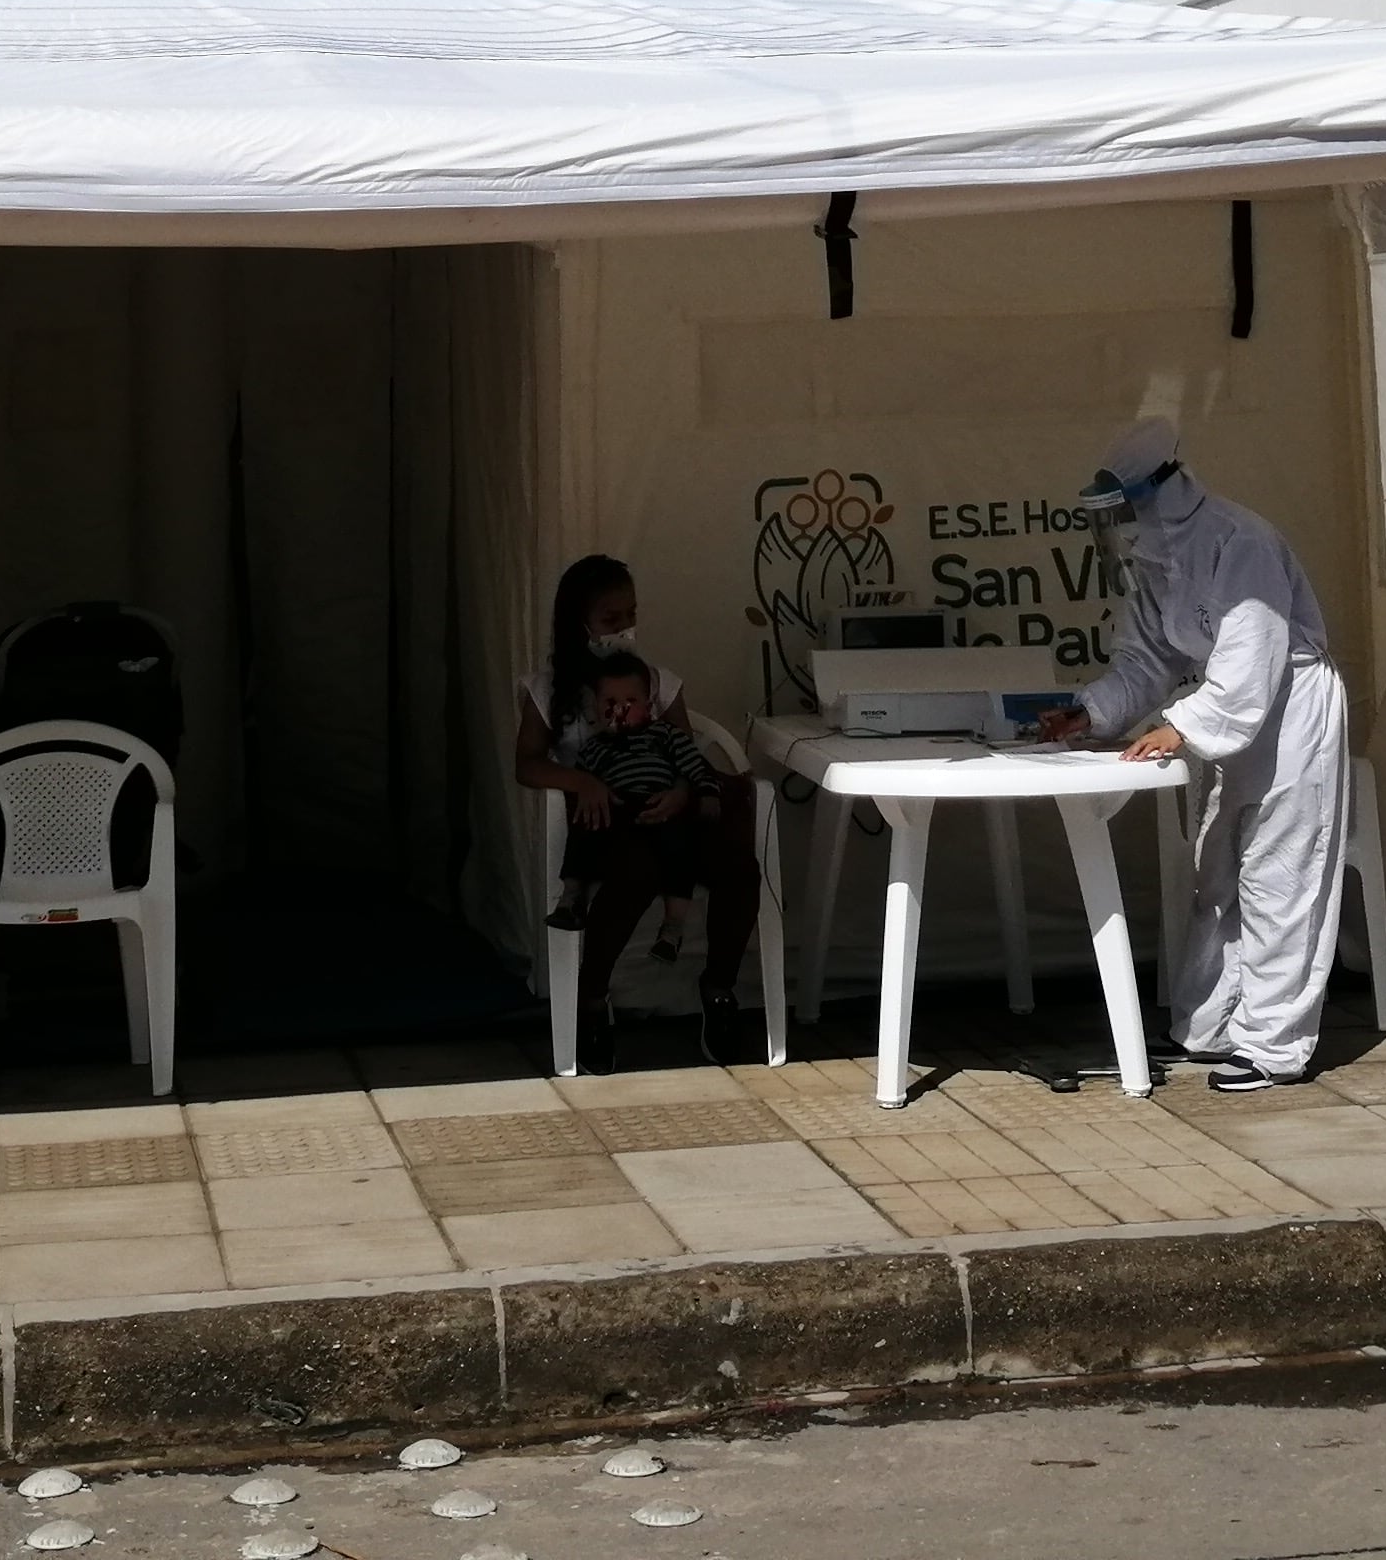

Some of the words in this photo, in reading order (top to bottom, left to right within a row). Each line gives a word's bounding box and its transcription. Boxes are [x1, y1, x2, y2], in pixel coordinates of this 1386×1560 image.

[928, 502, 1016, 541] E.S.E.
[931, 553, 1042, 608] San
[1018, 608, 1115, 666] Paú
